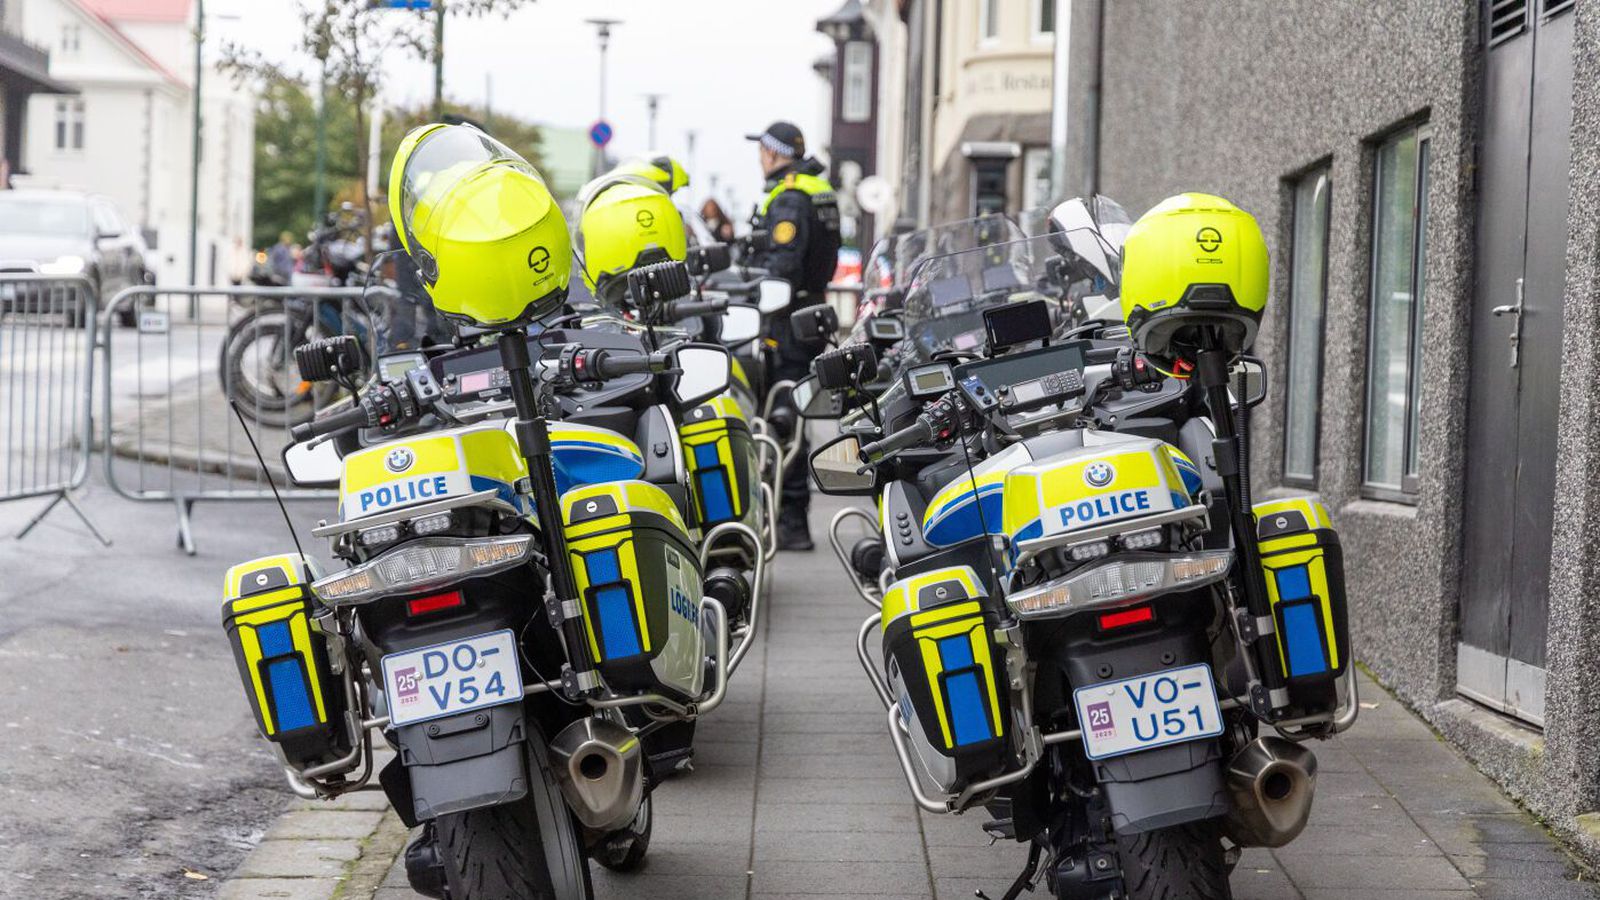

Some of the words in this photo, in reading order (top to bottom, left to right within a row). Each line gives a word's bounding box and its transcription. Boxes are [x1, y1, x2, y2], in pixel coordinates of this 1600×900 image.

[360, 476, 448, 512] POLICE
[1059, 490, 1150, 527] POLICE
[423, 643, 500, 680] DO-
[397, 674, 416, 692] 25
[428, 671, 506, 710] V54
[1124, 677, 1201, 709] VO-
[1090, 708, 1110, 726] 25
[1132, 705, 1204, 742] U51
